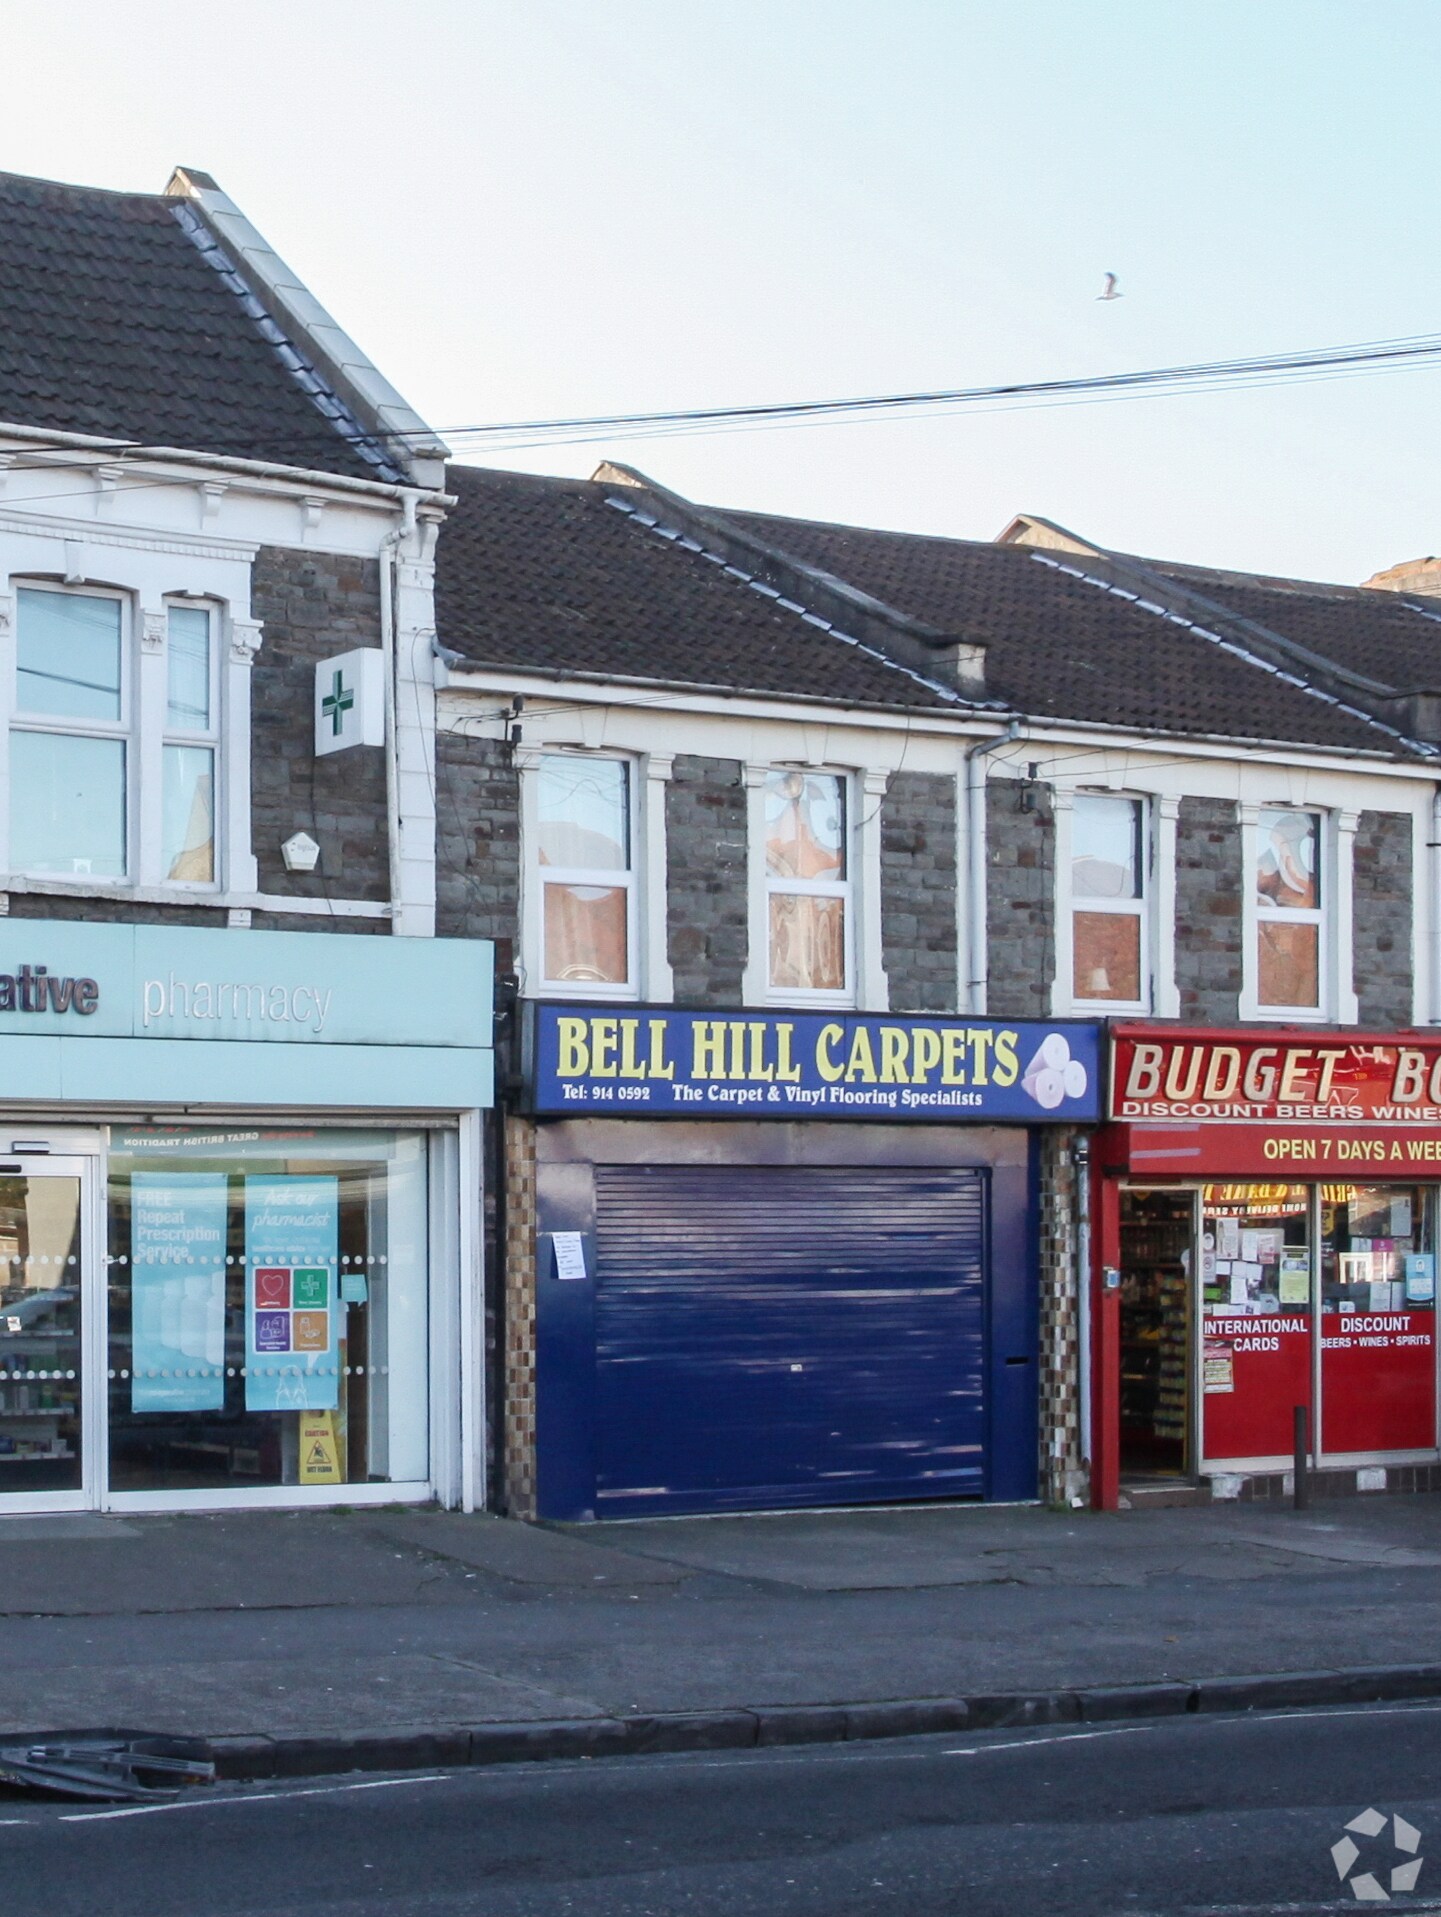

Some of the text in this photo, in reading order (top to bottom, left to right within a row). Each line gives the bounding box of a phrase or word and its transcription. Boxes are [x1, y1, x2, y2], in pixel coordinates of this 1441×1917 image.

[143, 971, 332, 1033] pharmacy
[556, 1017, 1019, 1087] BELL HILL CARPETS
[1125, 1043, 1346, 1102] BUDGET
[562, 1083, 650, 1100] Tel: 914 0592
[672, 1084, 982, 1108] The Carpet & Vinyl Flooring Specialists
[1122, 1102, 1441, 1120] DISCOUNT BEERS WINE
[1264, 1139, 1316, 1160] OPEN
[1320, 1140, 1332, 1160] 7
[1338, 1140, 1385, 1161] DAYS
[1390, 1141, 1403, 1160] A
[137, 1209, 185, 1225] Repeat
[251, 1208, 331, 1232] pharmacist
[137, 1226, 220, 1242] Prescription
[137, 1243, 189, 1259] Service
[1204, 1319, 1308, 1334] INTERNATIONAL
[1340, 1316, 1410, 1332] DISCOUNT
[1233, 1337, 1279, 1351] CARDS
[1320, 1335, 1431, 1348] BEERS WINES SPIRITS
